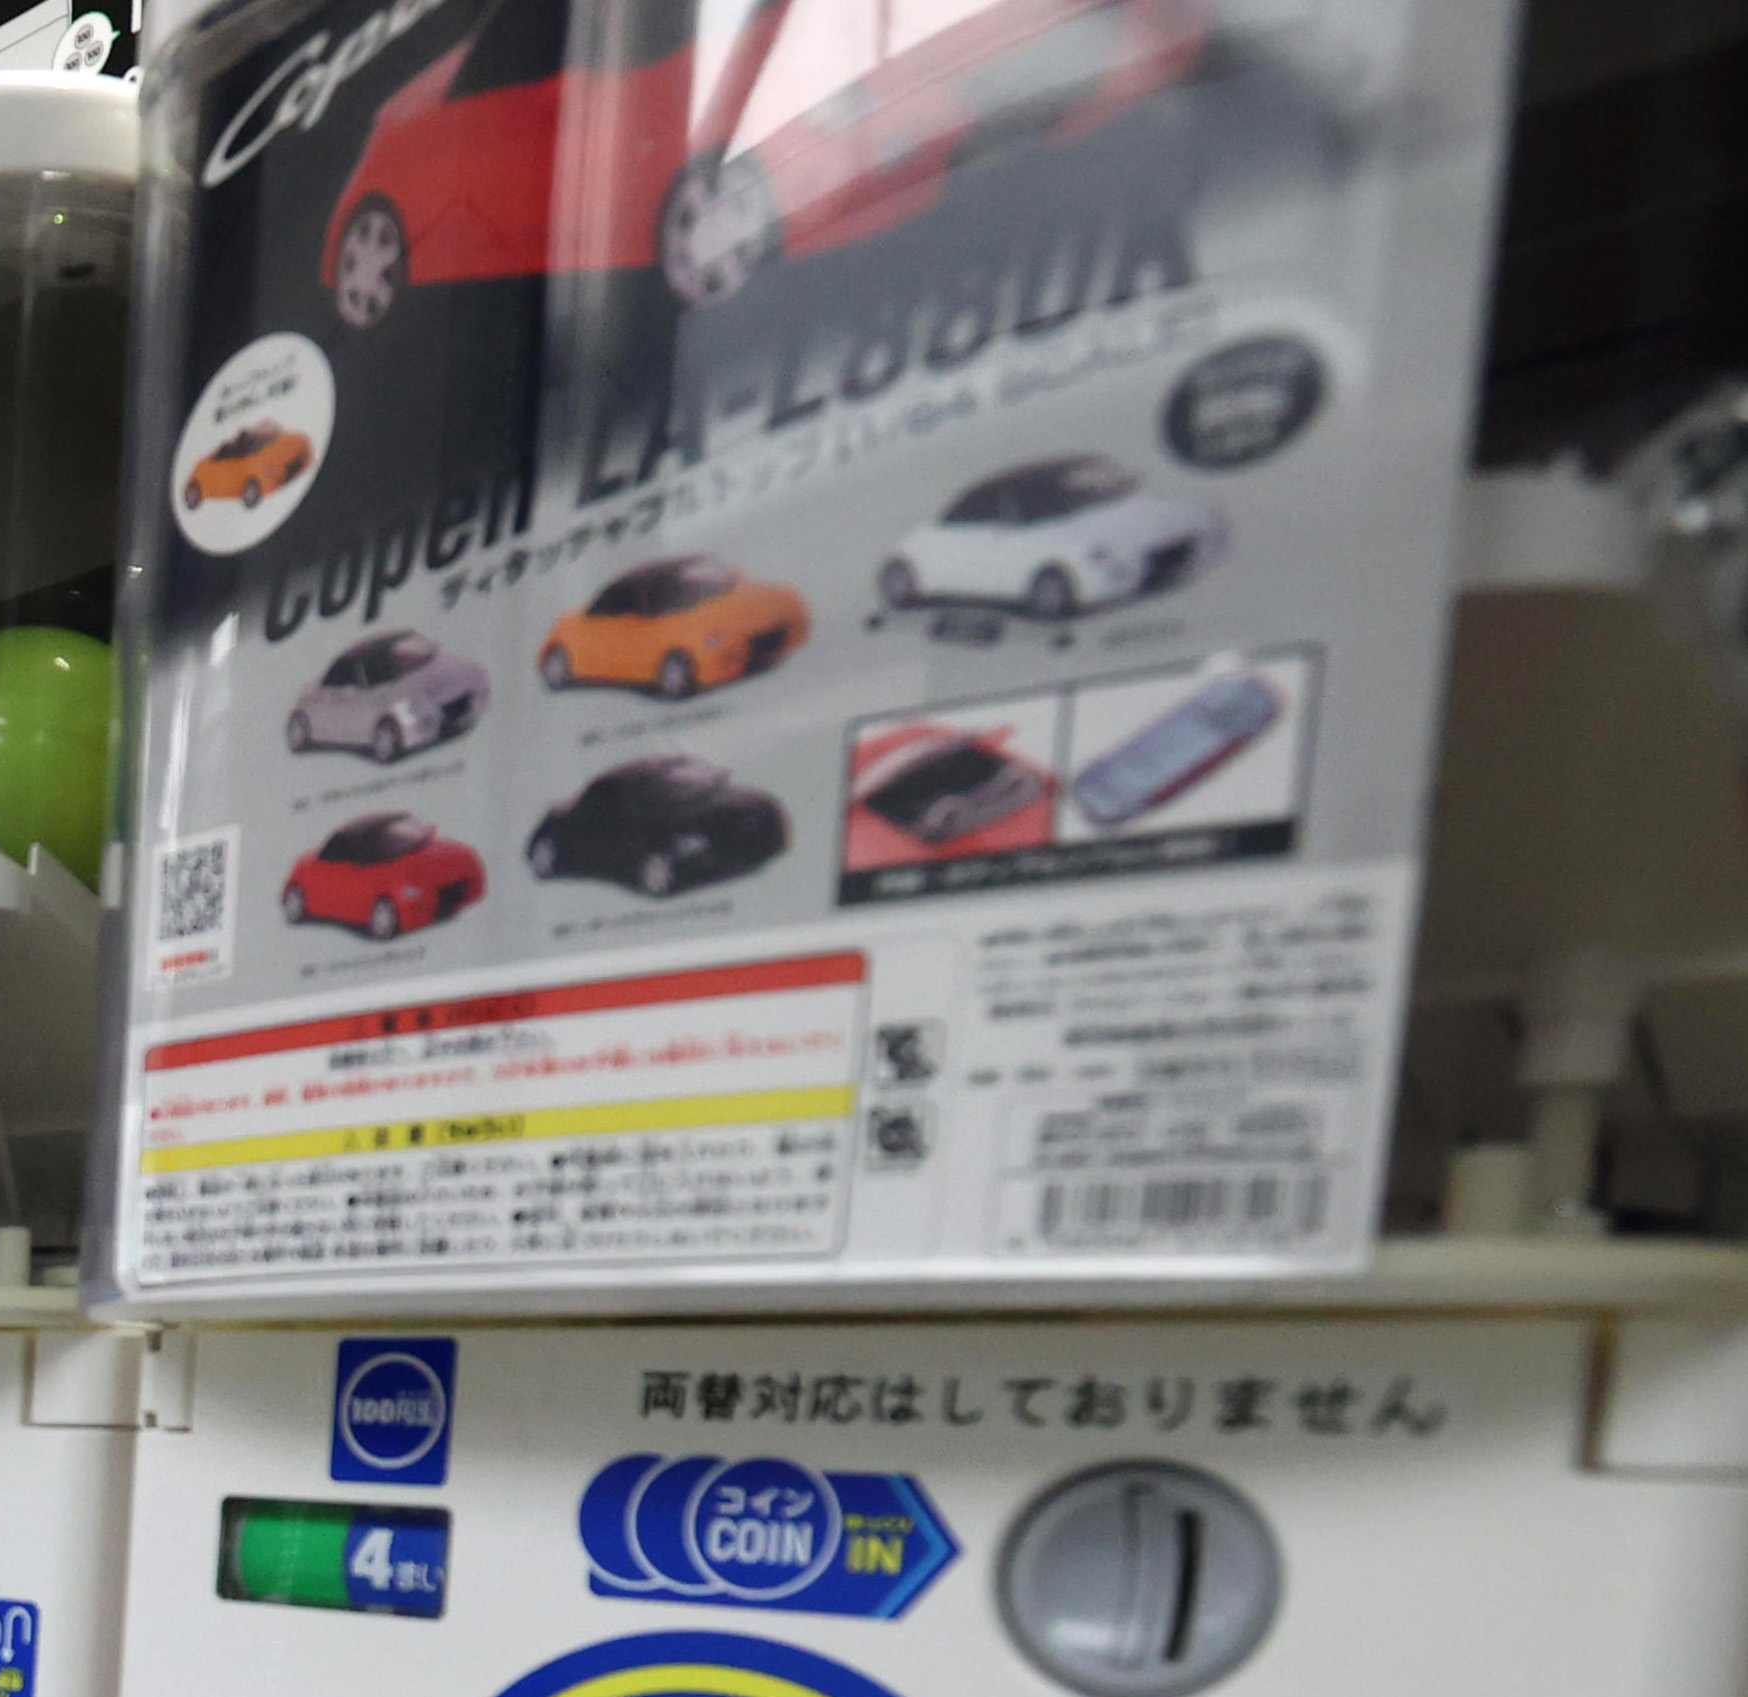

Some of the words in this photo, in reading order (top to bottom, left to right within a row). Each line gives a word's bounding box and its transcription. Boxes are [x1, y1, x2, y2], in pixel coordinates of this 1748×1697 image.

[641, 1371, 1448, 1437] 両替対応はしておりません
[713, 1487, 815, 1513] コイン
[707, 1522, 813, 1567] COIN
[847, 1535, 903, 1575] IN
